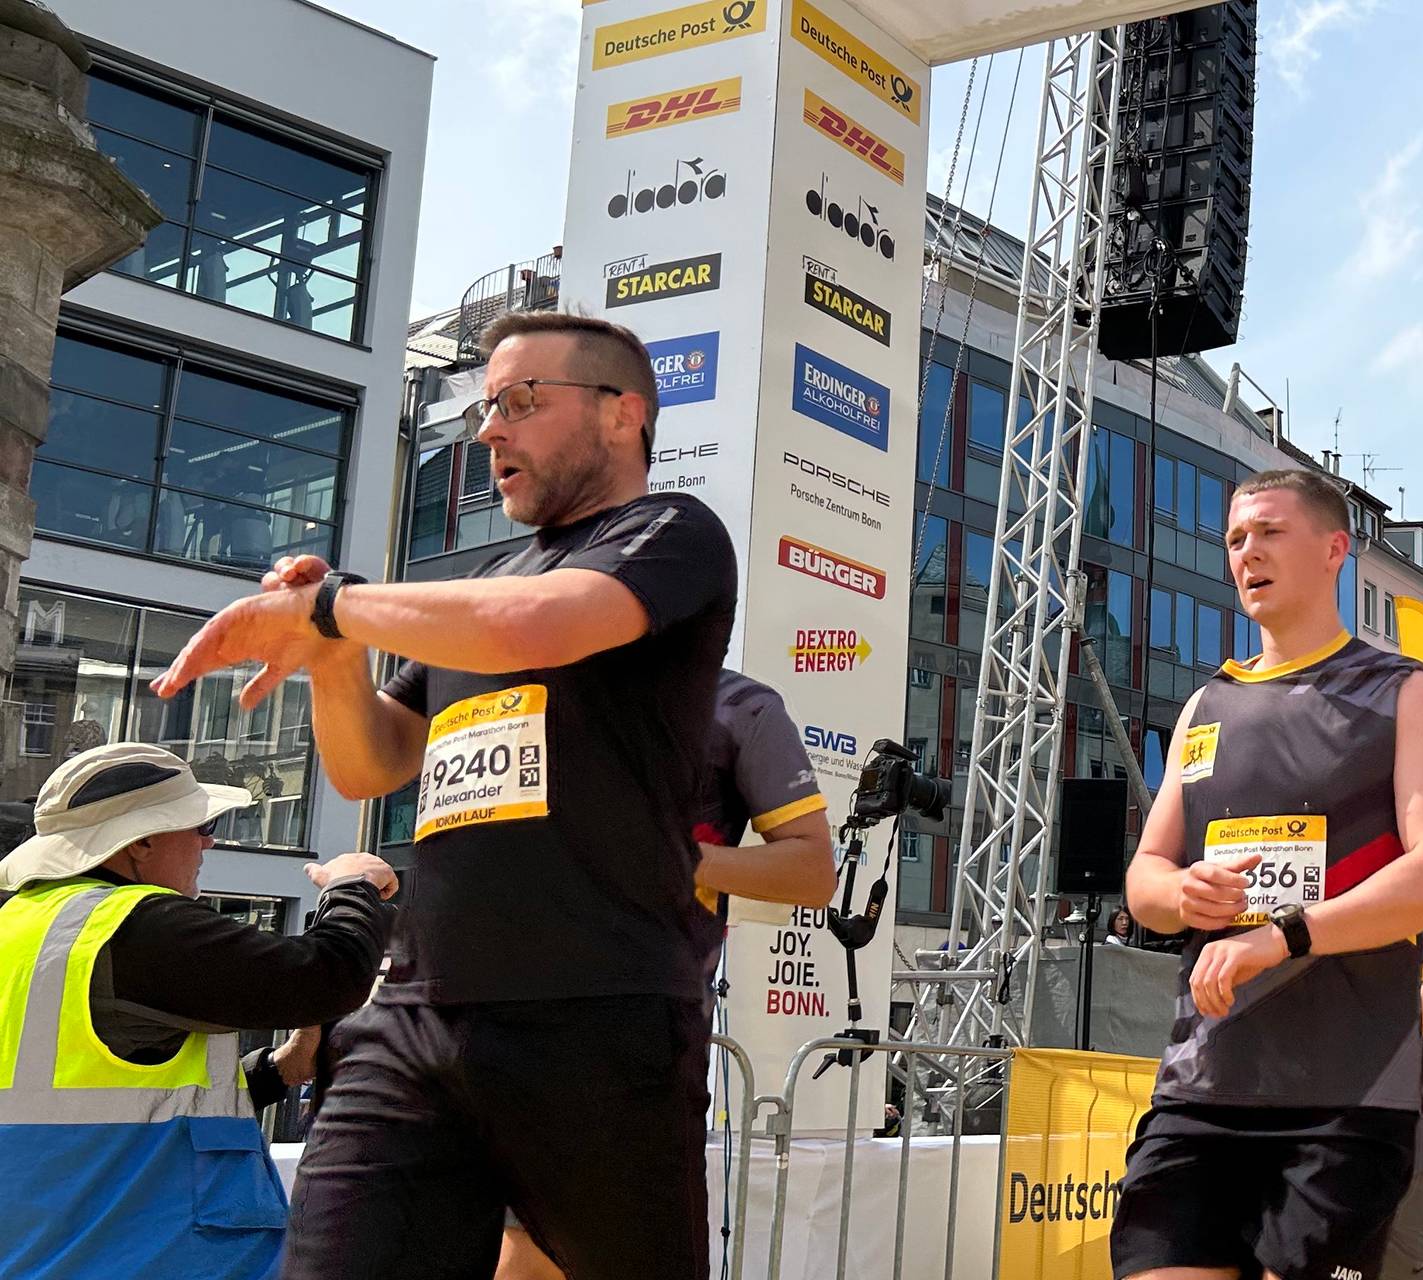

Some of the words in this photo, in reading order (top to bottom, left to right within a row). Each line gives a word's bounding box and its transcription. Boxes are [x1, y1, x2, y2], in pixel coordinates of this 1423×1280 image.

[604, 28, 676, 57] Deutsche
[681, 16, 716, 41] Post
[800, 16, 857, 70] Deutsche
[860, 57, 887, 90] Post
[623, 87, 718, 130] DHL
[818, 106, 892, 171] DHL
[607, 158, 727, 219] diadora
[806, 171, 895, 262] diadora
[609, 259, 638, 277] RENT
[638, 256, 646, 270] A
[807, 260, 829, 280] RENT
[830, 270, 837, 283] A
[616, 263, 711, 299] STARCAR
[813, 281, 885, 336] STARCAR
[804, 362, 867, 412] ERDINGER
[803, 388, 881, 432] ALKOHOLFREI
[650, 443, 719, 464] SCHE
[648, 479, 675, 491] trum
[678, 475, 706, 488] Bonn
[784, 451, 891, 508] PORSCHE
[791, 483, 825, 508] Porsche
[826, 497, 860, 522] Zentrum
[861, 512, 882, 531] Bonn
[789, 545, 878, 596] BÜRGER
[796, 630, 857, 650] DEXTRO
[795, 651, 857, 673] ENERGY
[472, 705, 495, 719] Post
[468, 725, 506, 738] Marathon
[507, 721, 529, 731] Bonn
[804, 725, 857, 756] SWB
[434, 744, 511, 791] 9240
[808, 751, 830, 766] nergie
[831, 758, 844, 767] und
[846, 759, 863, 771] Wass
[433, 784, 503, 810] Alexander
[435, 813, 462, 828] 10KM
[464, 808, 496, 823] LAUF
[1220, 828, 1260, 838] Deutsche
[1262, 826, 1284, 835] Post
[1260, 845, 1293, 853] Marathon
[1295, 844, 1313, 852] Bonn
[1247, 893, 1278, 905] oritz
[769, 930, 812, 957] JOY.
[768, 960, 820, 988] JOIE.
[767, 989, 830, 1018] BONN.
[1009, 1169, 1118, 1224] Deutsch
[1330, 1265, 1363, 1280] JAKO
